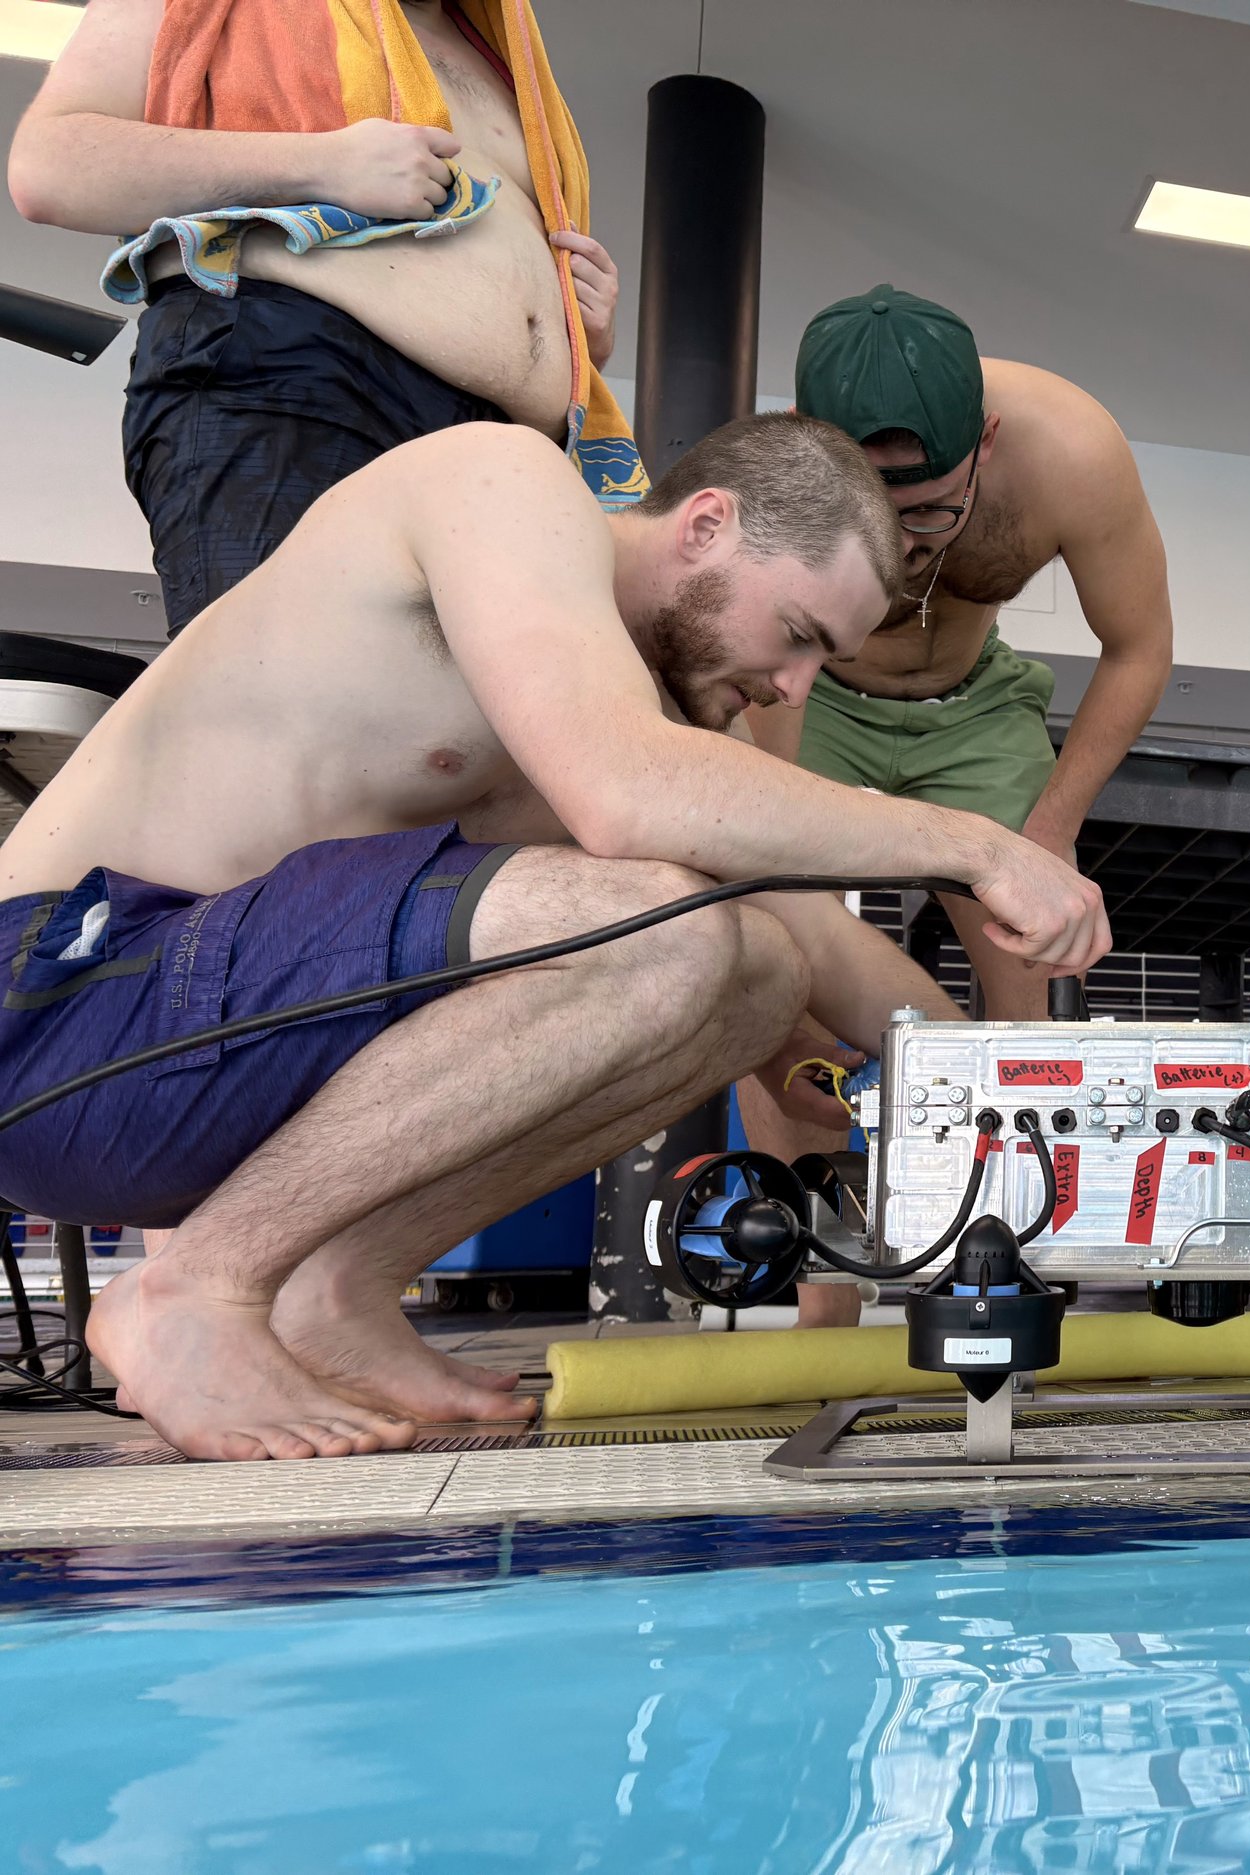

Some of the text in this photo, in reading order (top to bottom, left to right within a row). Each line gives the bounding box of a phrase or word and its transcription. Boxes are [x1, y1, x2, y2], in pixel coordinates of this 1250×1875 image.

[174, 934, 191, 974] POLO
[187, 932, 200, 959] 1890
[171, 979, 184, 1010] U.S.
[1001, 1062, 1064, 1081] Batterie
[1161, 1065, 1224, 1086] Batterie
[1235, 1146, 1245, 1158] 4
[1056, 1151, 1074, 1206] Extra
[1133, 1163, 1154, 1219] Depth
